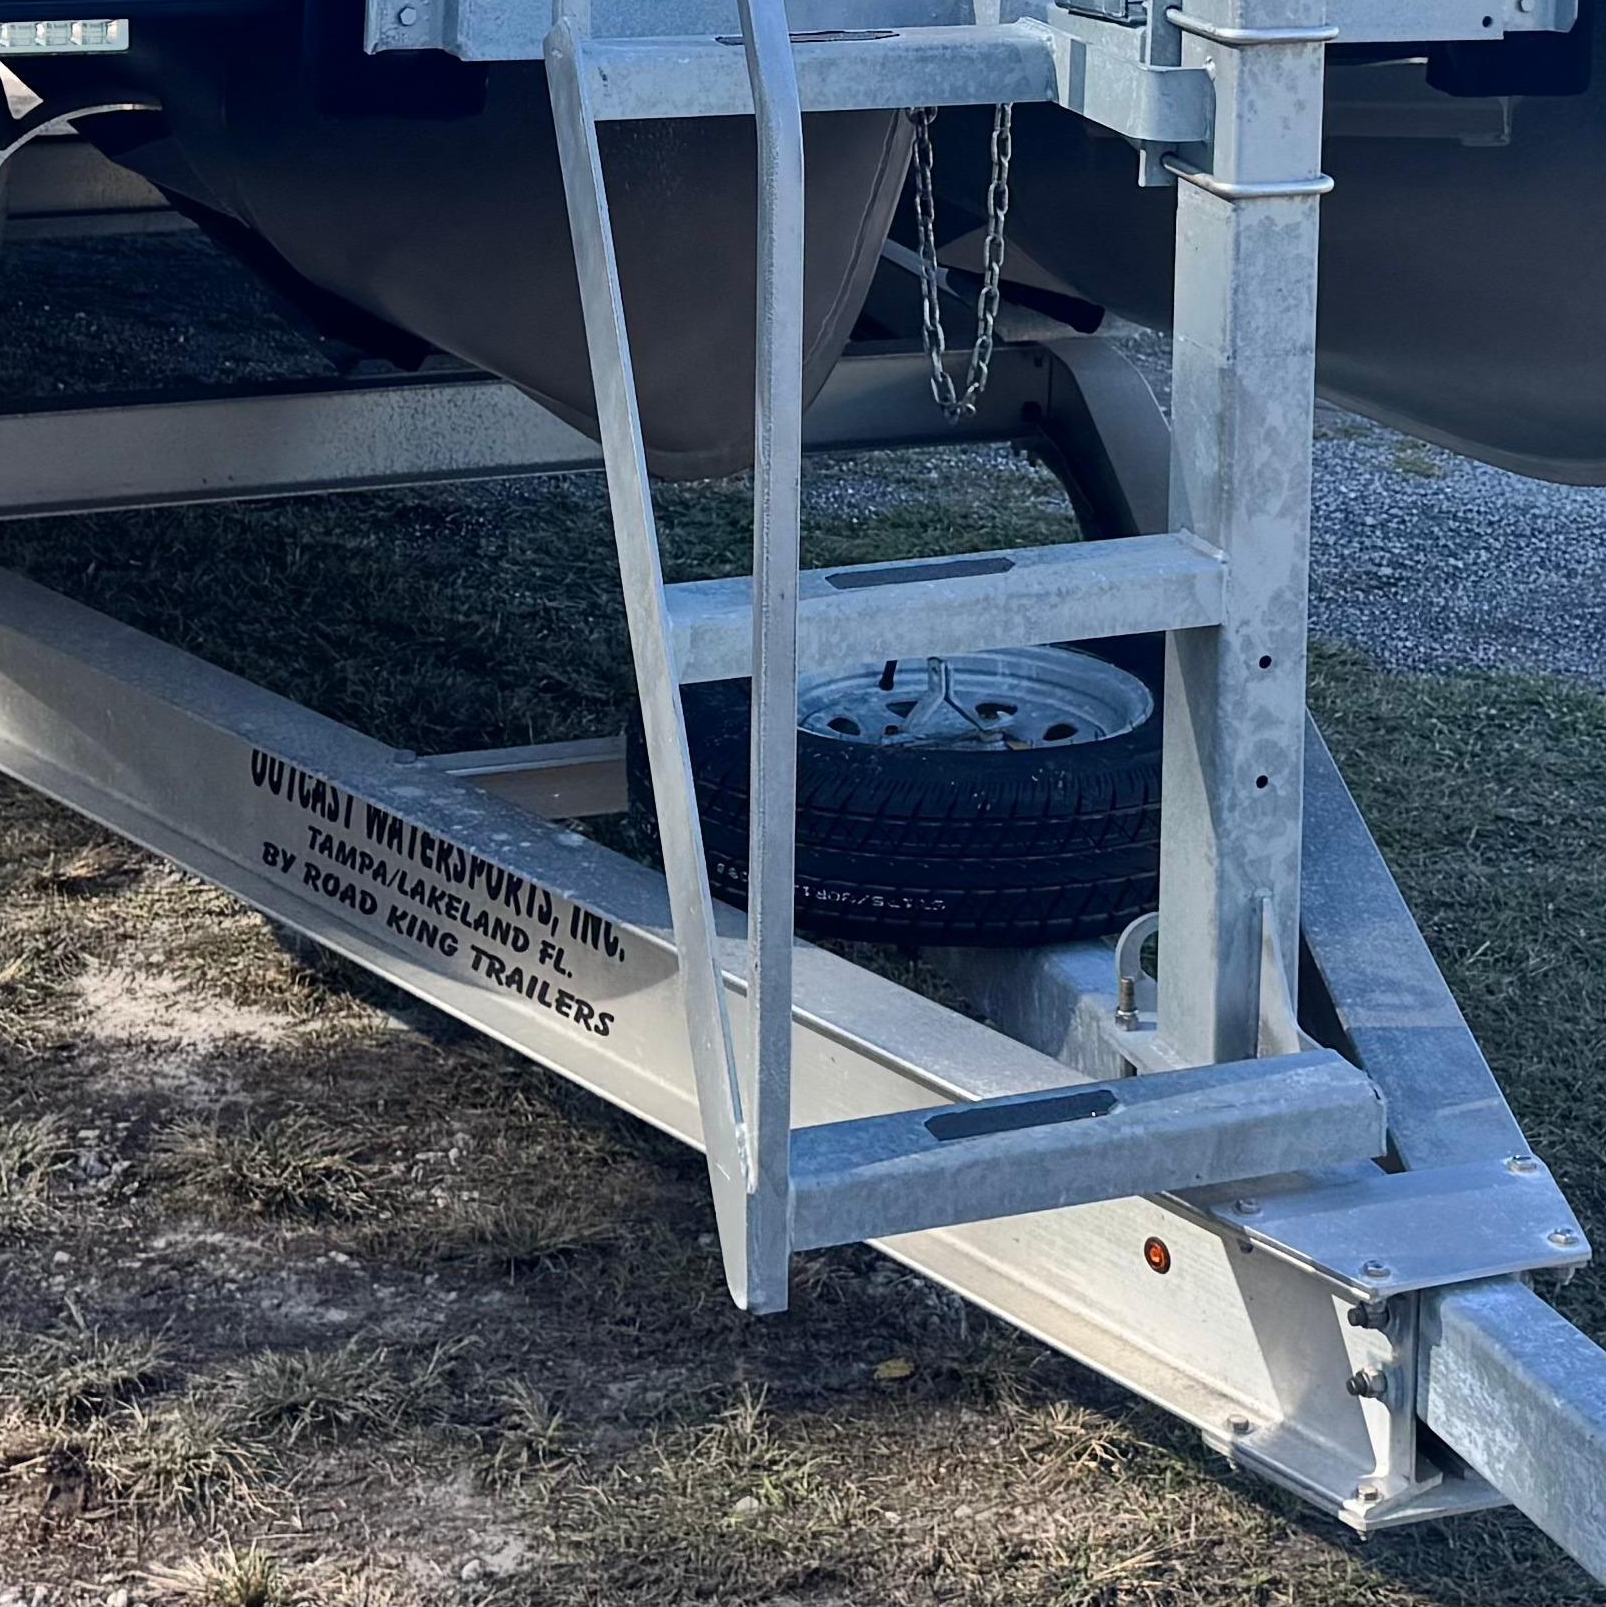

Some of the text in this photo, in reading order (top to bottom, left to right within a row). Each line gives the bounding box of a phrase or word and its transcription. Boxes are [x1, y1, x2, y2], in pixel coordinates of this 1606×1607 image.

[261, 841, 616, 1037] BY ROAD KING TRAILERS
[539, 939, 574, 979] FL.
